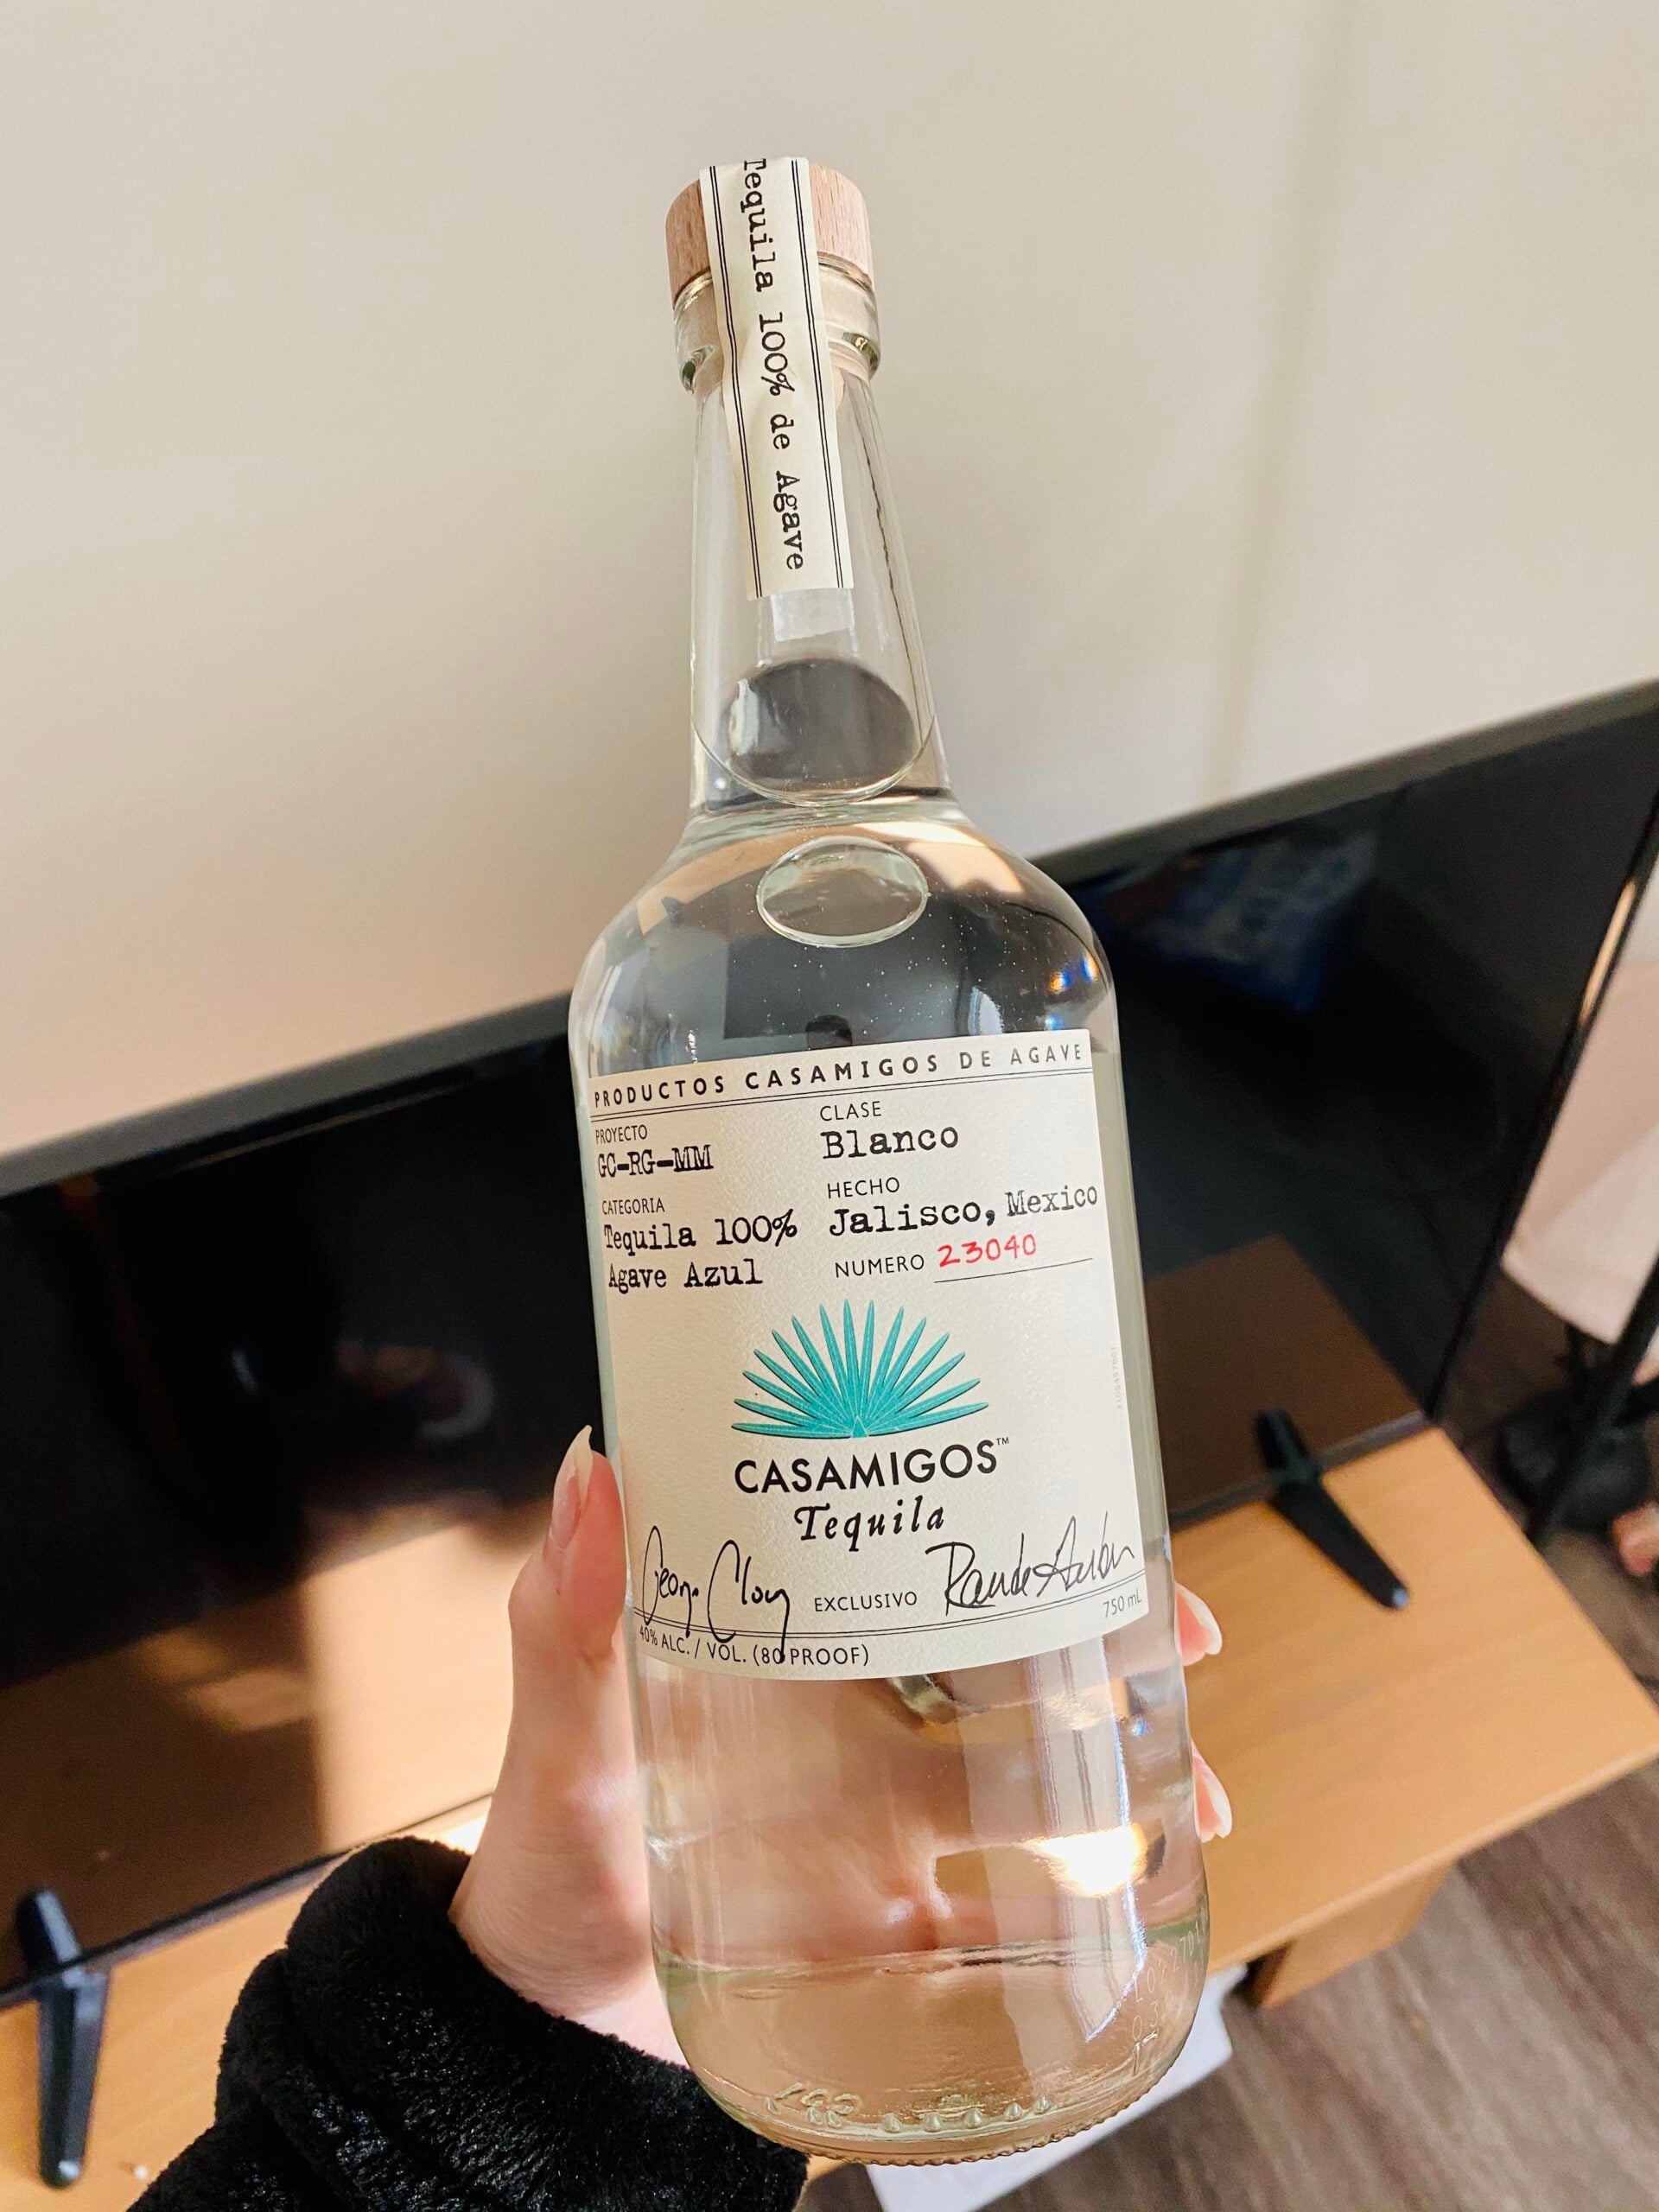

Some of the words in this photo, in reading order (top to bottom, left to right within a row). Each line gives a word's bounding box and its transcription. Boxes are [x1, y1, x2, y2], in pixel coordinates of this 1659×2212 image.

[740, 158, 775, 292] Tequila
[759, 312, 795, 396] 100%
[770, 414, 794, 449] de
[773, 470, 804, 569] Agave
[594, 1076, 724, 1108] PRODUCTOS
[745, 1054, 938, 1089] CASAMIGOS
[960, 1051, 991, 1069] DE
[1010, 1043, 1081, 1065] AGAVE
[820, 1101, 882, 1122] CLASE
[595, 1124, 647, 1144] PROYECTO
[821, 1127, 958, 1160] Blanco
[602, 1198, 665, 1215] CATEGORIA
[827, 1177, 899, 1199] HECHO
[829, 1202, 995, 1236] Jalisco,
[1005, 1185, 1097, 1217] Mexico
[604, 1223, 696, 1256] Tequila
[715, 1209, 798, 1247] 100%
[608, 1263, 666, 1294] Agave
[683, 1259, 763, 1287] Azul
[835, 1254, 925, 1278] NUMERO
[938, 1233, 1036, 1268] 23040
[734, 1439, 997, 1494] CASAMIGOS
[794, 1496, 944, 1552] Tequila
[814, 1591, 918, 1612] EXCLUSIVO
[1103, 1597, 1124, 1618] 750
[1127, 1589, 1142, 1609] mL
[639, 1624, 658, 1647] 40%
[661, 1637, 690, 1656] ALC.
[707, 1643, 747, 1662] VOL.
[791, 1644, 869, 1667] PROOF)
